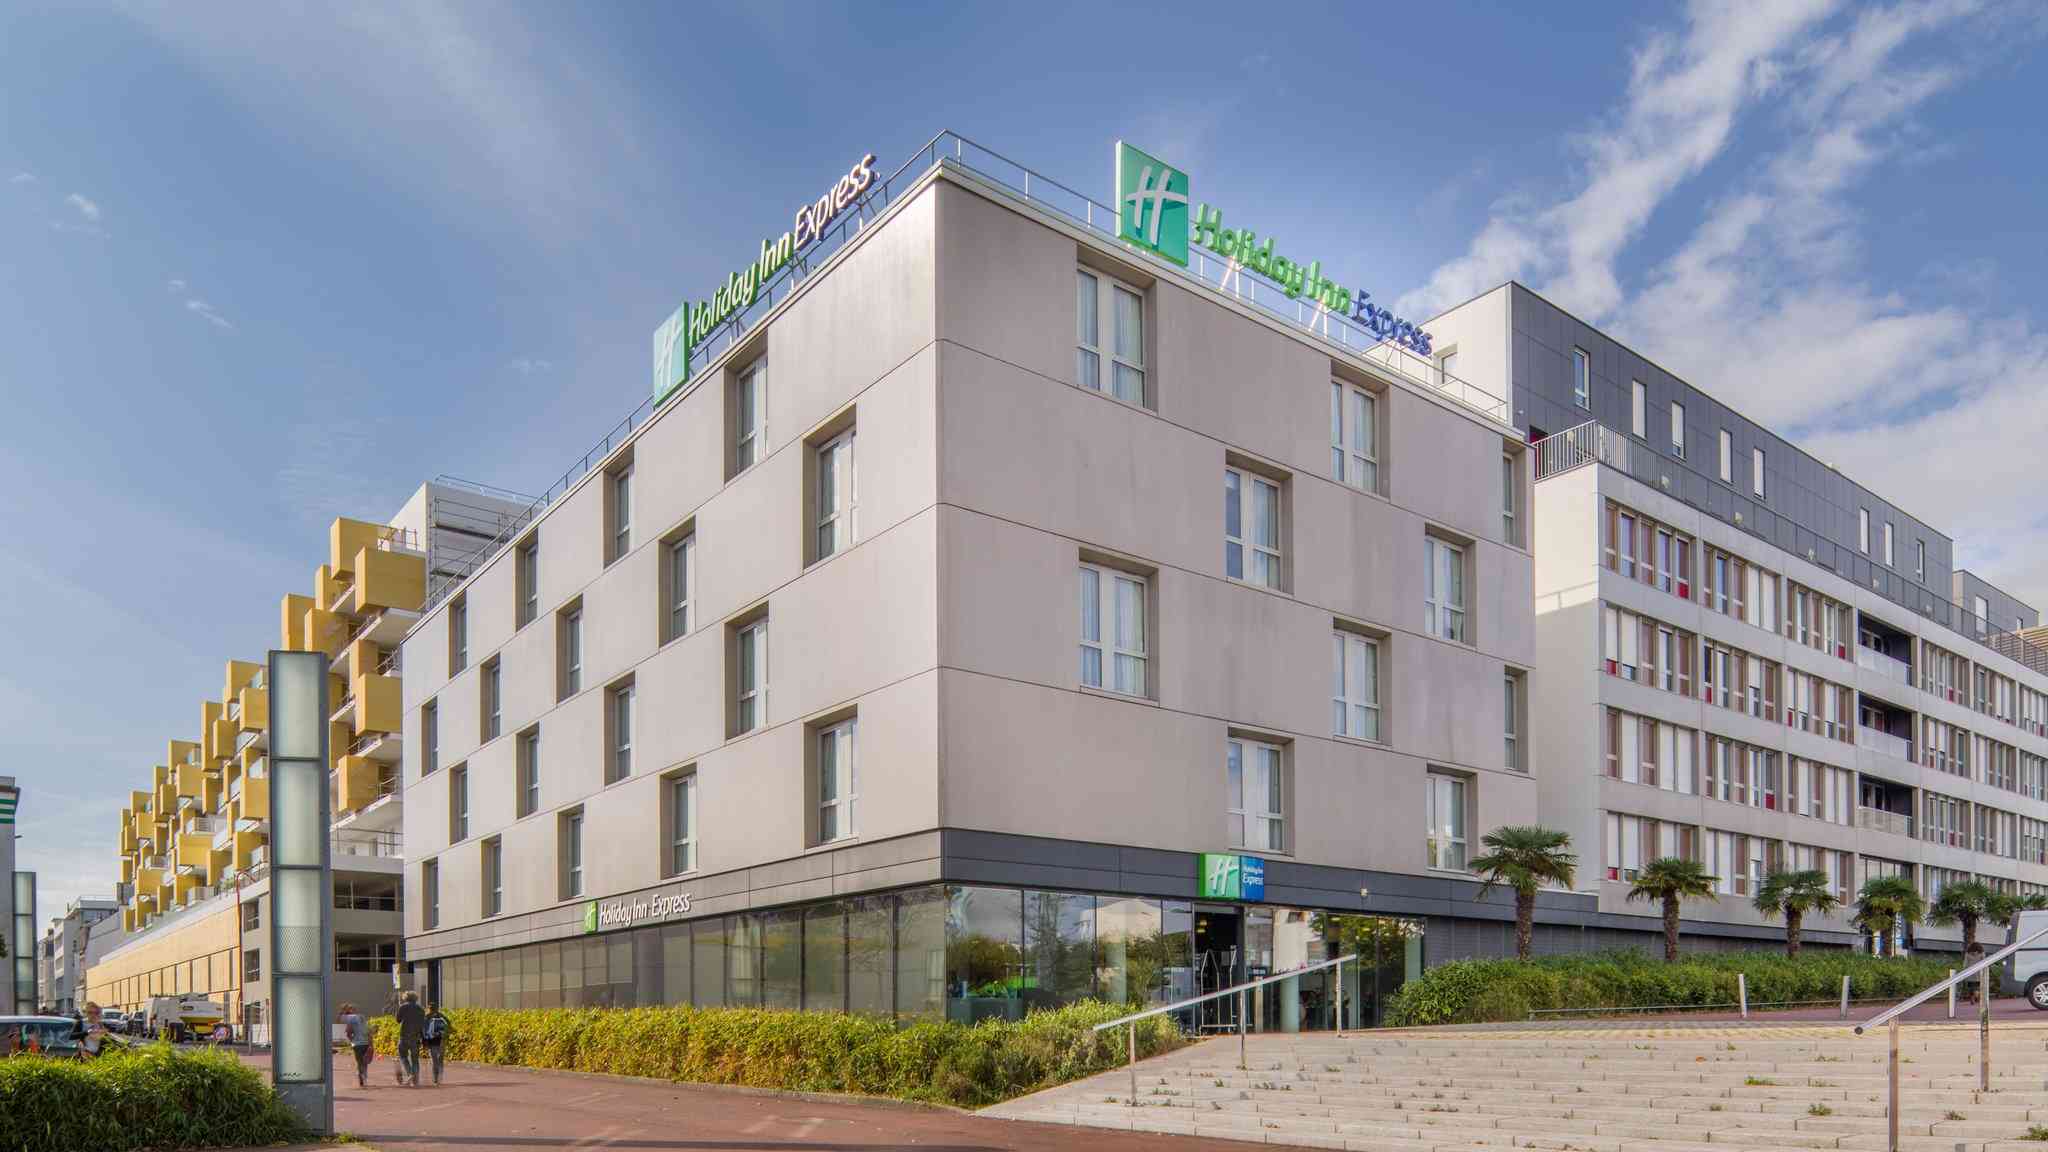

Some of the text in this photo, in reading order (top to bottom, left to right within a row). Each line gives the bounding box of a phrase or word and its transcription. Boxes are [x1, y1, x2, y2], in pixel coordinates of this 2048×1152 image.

[689, 262, 760, 347] Holiday
[759, 232, 795, 283] Inn
[794, 153, 877, 250] Express
[1191, 202, 1433, 356] Holiday Inn Express
[600, 898, 632, 927] Holiday
[632, 898, 648, 920] Inn
[652, 894, 690, 919] Express
